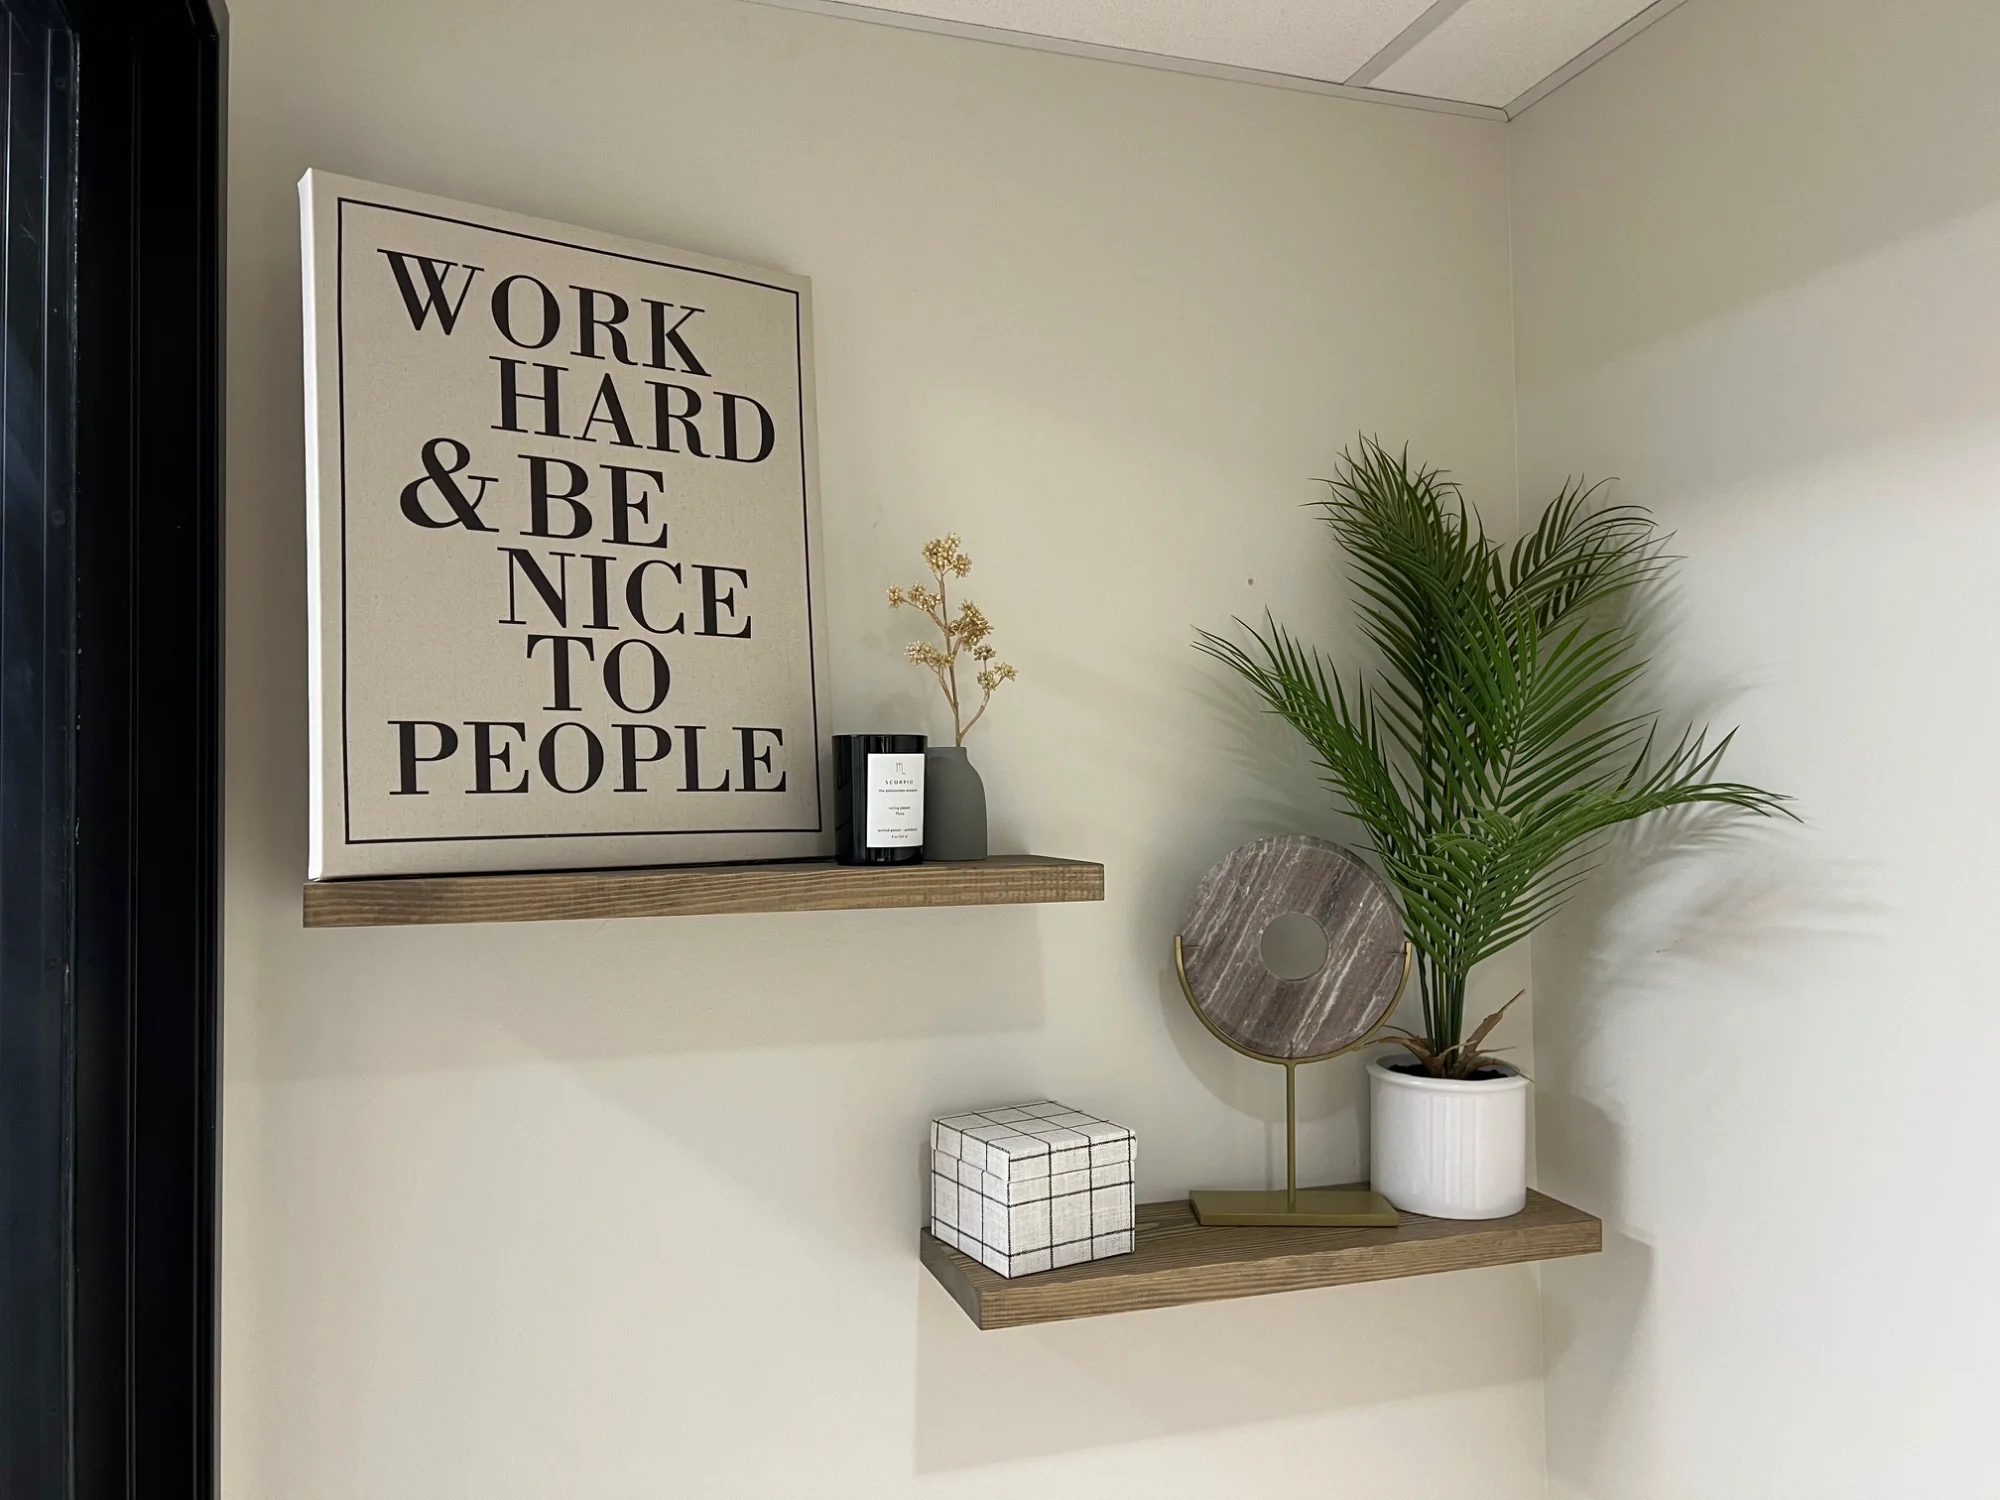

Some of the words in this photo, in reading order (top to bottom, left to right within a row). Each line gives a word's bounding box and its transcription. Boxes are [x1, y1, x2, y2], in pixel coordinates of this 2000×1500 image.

[376, 248, 712, 378] WORK
[488, 355, 775, 464] HARD
[399, 436, 500, 533] &
[516, 453, 668, 549] BE
[496, 546, 753, 639] NICE
[525, 633, 671, 714] TO
[387, 720, 787, 796] PEOPLE
